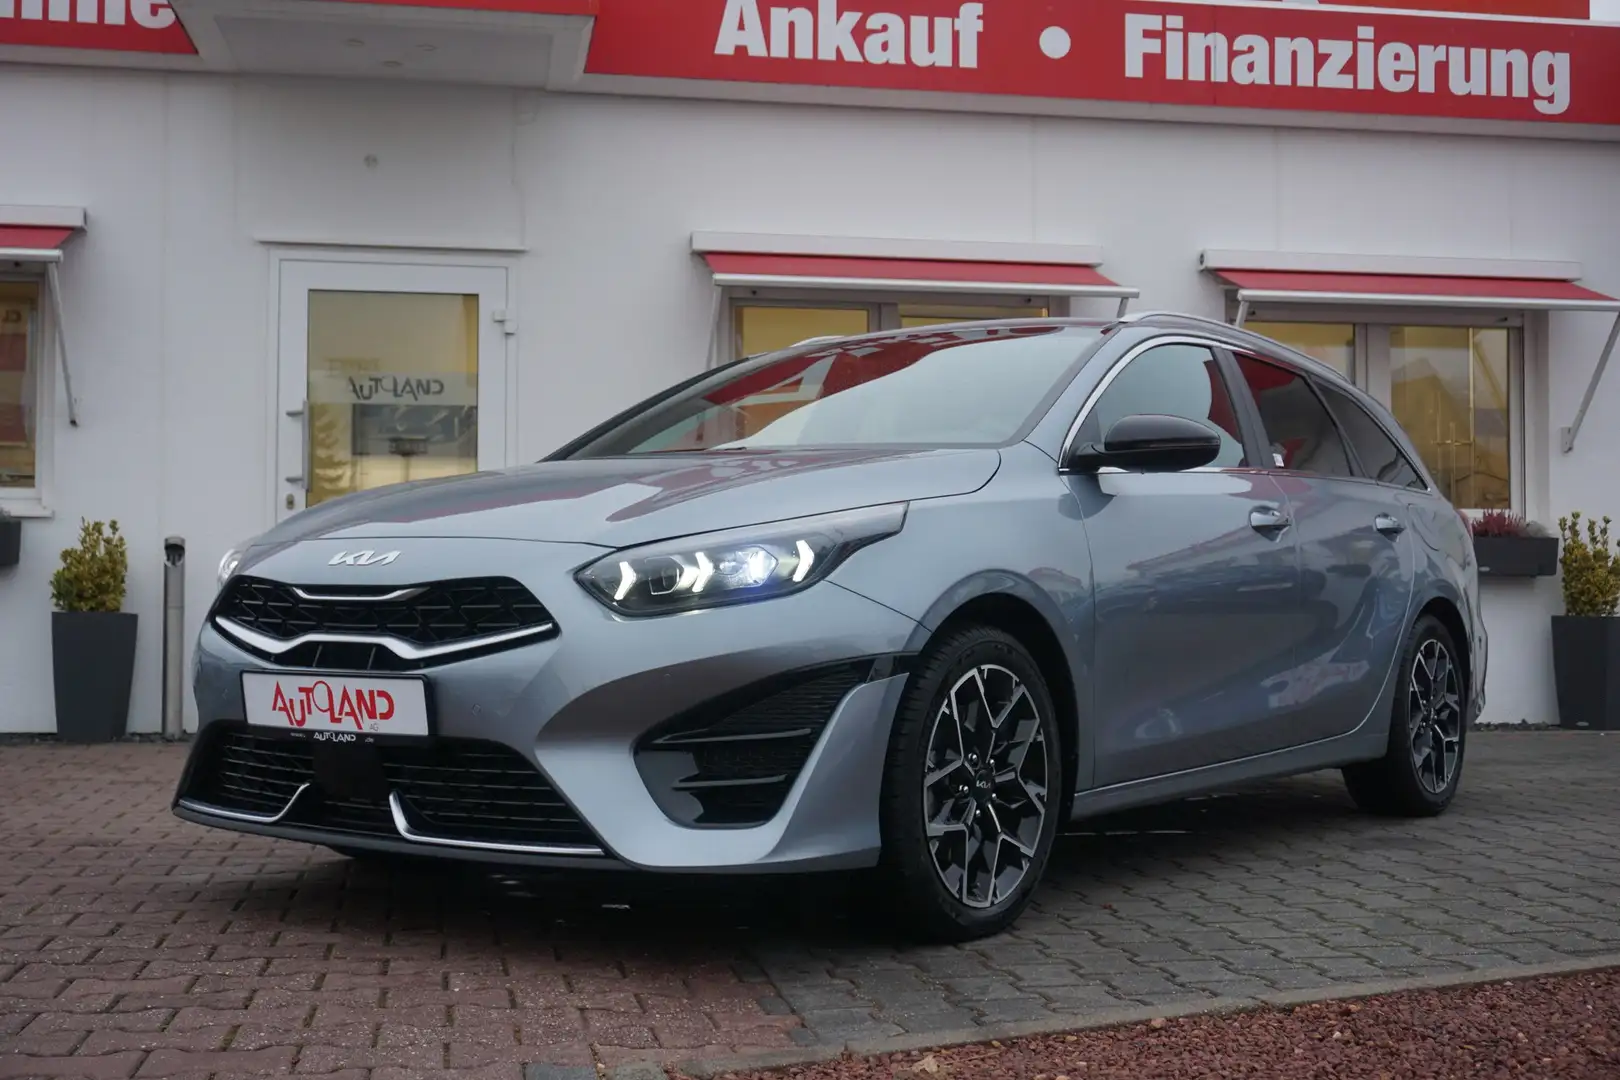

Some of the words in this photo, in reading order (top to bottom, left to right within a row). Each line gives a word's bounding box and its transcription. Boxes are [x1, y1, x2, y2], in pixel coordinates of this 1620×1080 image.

[714, 0, 984, 69] Ankauf
[1124, 13, 1571, 115] Finanzierung
[328, 550, 401, 566] KIA
[272, 680, 395, 730] AUTOLAND
[313, 731, 357, 743] AUTOLAND
